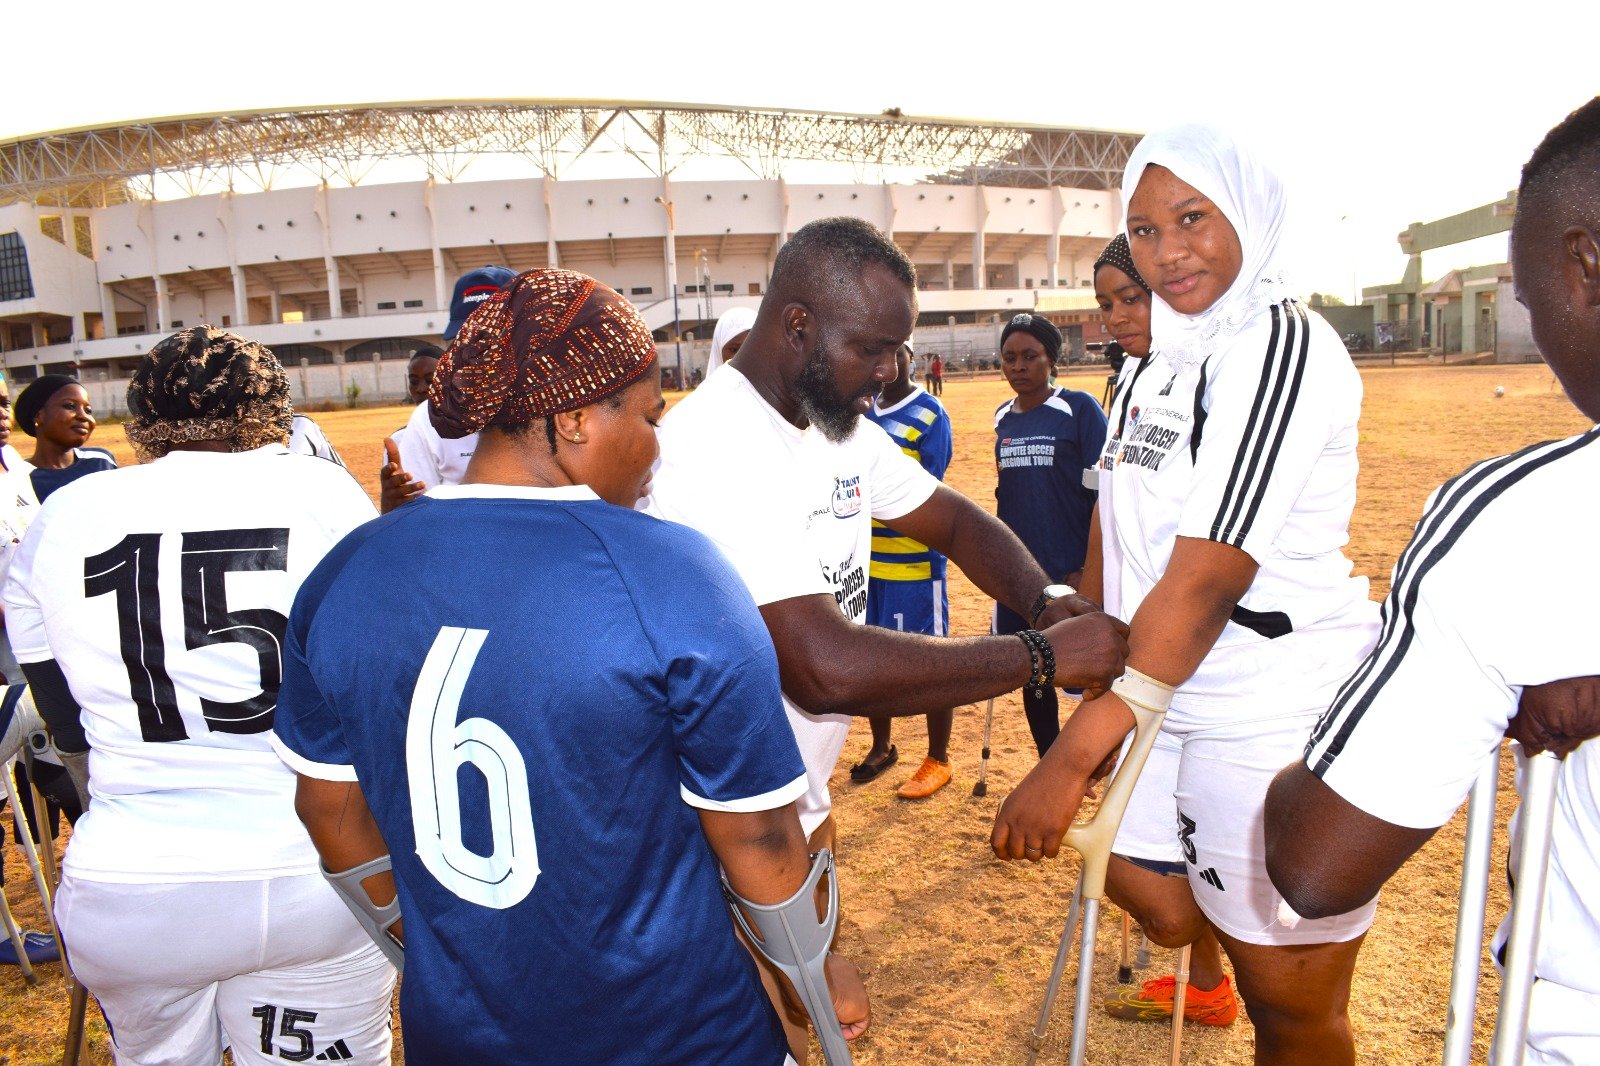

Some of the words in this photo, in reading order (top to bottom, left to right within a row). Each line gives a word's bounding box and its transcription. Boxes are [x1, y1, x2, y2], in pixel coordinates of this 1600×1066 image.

[1000, 445, 1027, 458] AMPUTEE
[1027, 444, 1055, 456] SOCCER
[1001, 456, 1032, 468] REGIONAL
[1033, 455, 1054, 466] TOUR
[840, 475, 860, 488] TALNT
[84, 528, 289, 742] 15
[405, 626, 542, 909] 6
[252, 1005, 318, 1062] 15
